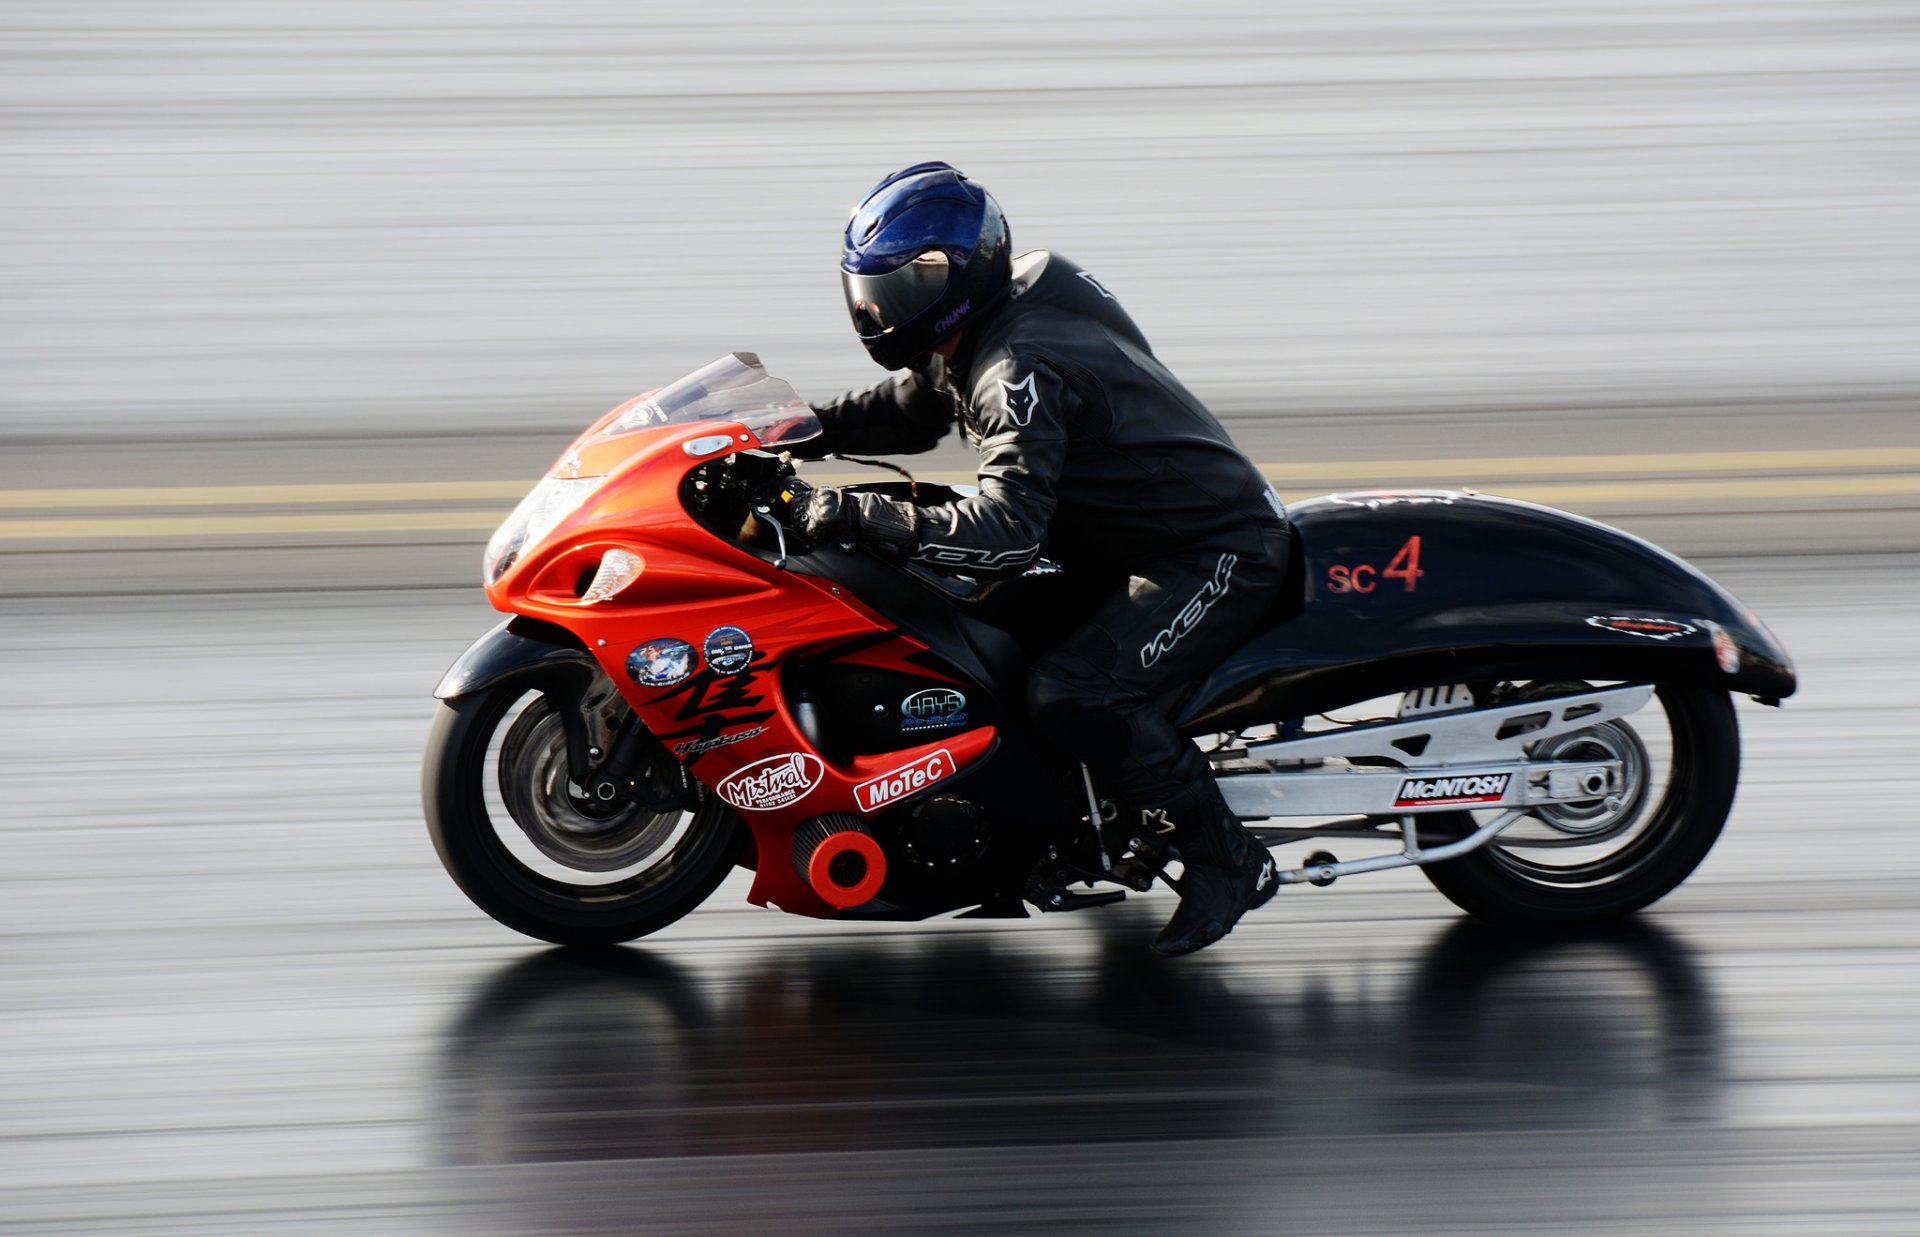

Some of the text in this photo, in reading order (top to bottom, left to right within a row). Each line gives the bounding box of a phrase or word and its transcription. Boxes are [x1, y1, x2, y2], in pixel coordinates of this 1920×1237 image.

[1140, 553, 1238, 668] WOLF
[908, 694, 961, 715] HAYS
[673, 726, 766, 755] Hayabusa
[727, 752, 811, 807] Mistral
[869, 758, 942, 805] MoTeC
[1400, 775, 1508, 798] McINTOSH
